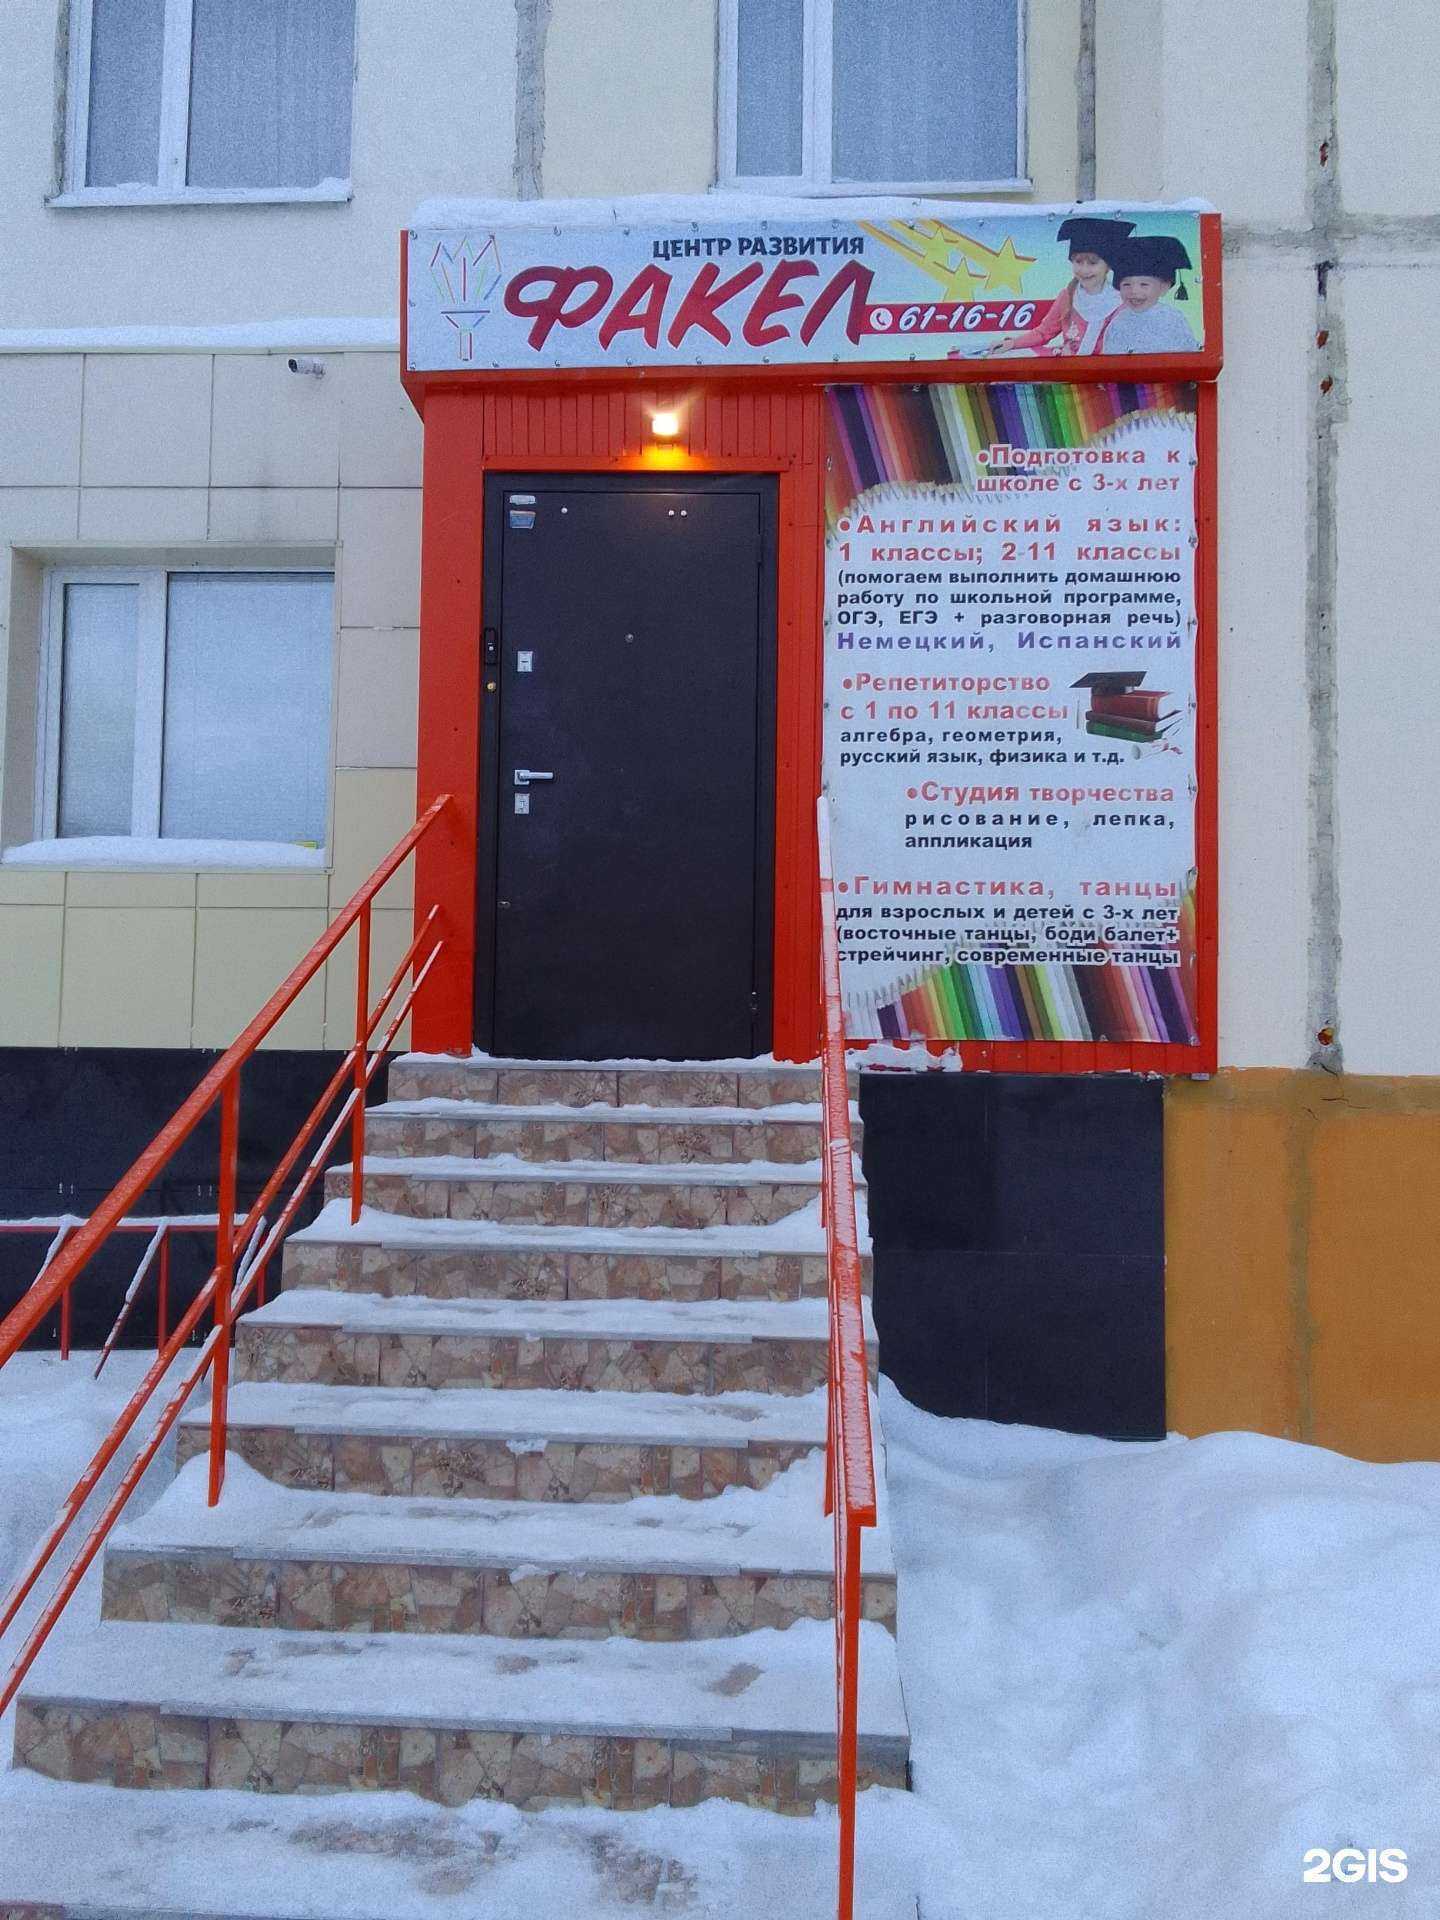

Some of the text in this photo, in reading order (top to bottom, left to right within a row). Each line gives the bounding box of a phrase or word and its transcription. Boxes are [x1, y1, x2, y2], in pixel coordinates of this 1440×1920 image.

[652, 235, 865, 260] ЦЕНТР РАЗВИТИЯ
[503, 258, 877, 352] ФАКЕЛ
[897, 302, 1036, 329] 61-16-16
[991, 446, 1180, 467] Подготовка к
[977, 473, 1180, 492] школе с 3-х лет
[857, 513, 1181, 533] Английский язык:
[839, 543, 1180, 564] 1 классы; 2-11 классы
[838, 570, 1181, 586] (помогаем выполнить домашнюю
[837, 590, 1181, 607] работу по школьной программе,
[838, 611, 884, 628] ОГЭ,
[900, 611, 937, 624] ЕГЭ
[980, 612, 1110, 628] разговорная
[1127, 610, 1181, 628] речь)
[837, 631, 1181, 653] Немецкий, Испанский
[855, 673, 1050, 694] Репетиторство
[840, 701, 1068, 719] с 1 по 11 классы
[840, 728, 1062, 746] алгебра, геометрия,
[839, 749, 1124, 767] русский язык, физика и т.д.
[920, 782, 1174, 806] Студия творчества
[905, 812, 1175, 830] рисование, лепка,
[905, 835, 1032, 850] аппликация
[854, 876, 1176, 899] Гимнастика, танцы
[836, 905, 1176, 922] для взрослых и детей с 3-х лет
[836, 926, 1176, 944] (восточные танцы, боди балет+
[837, 947, 1178, 965] стрейчинг, современные танцы
